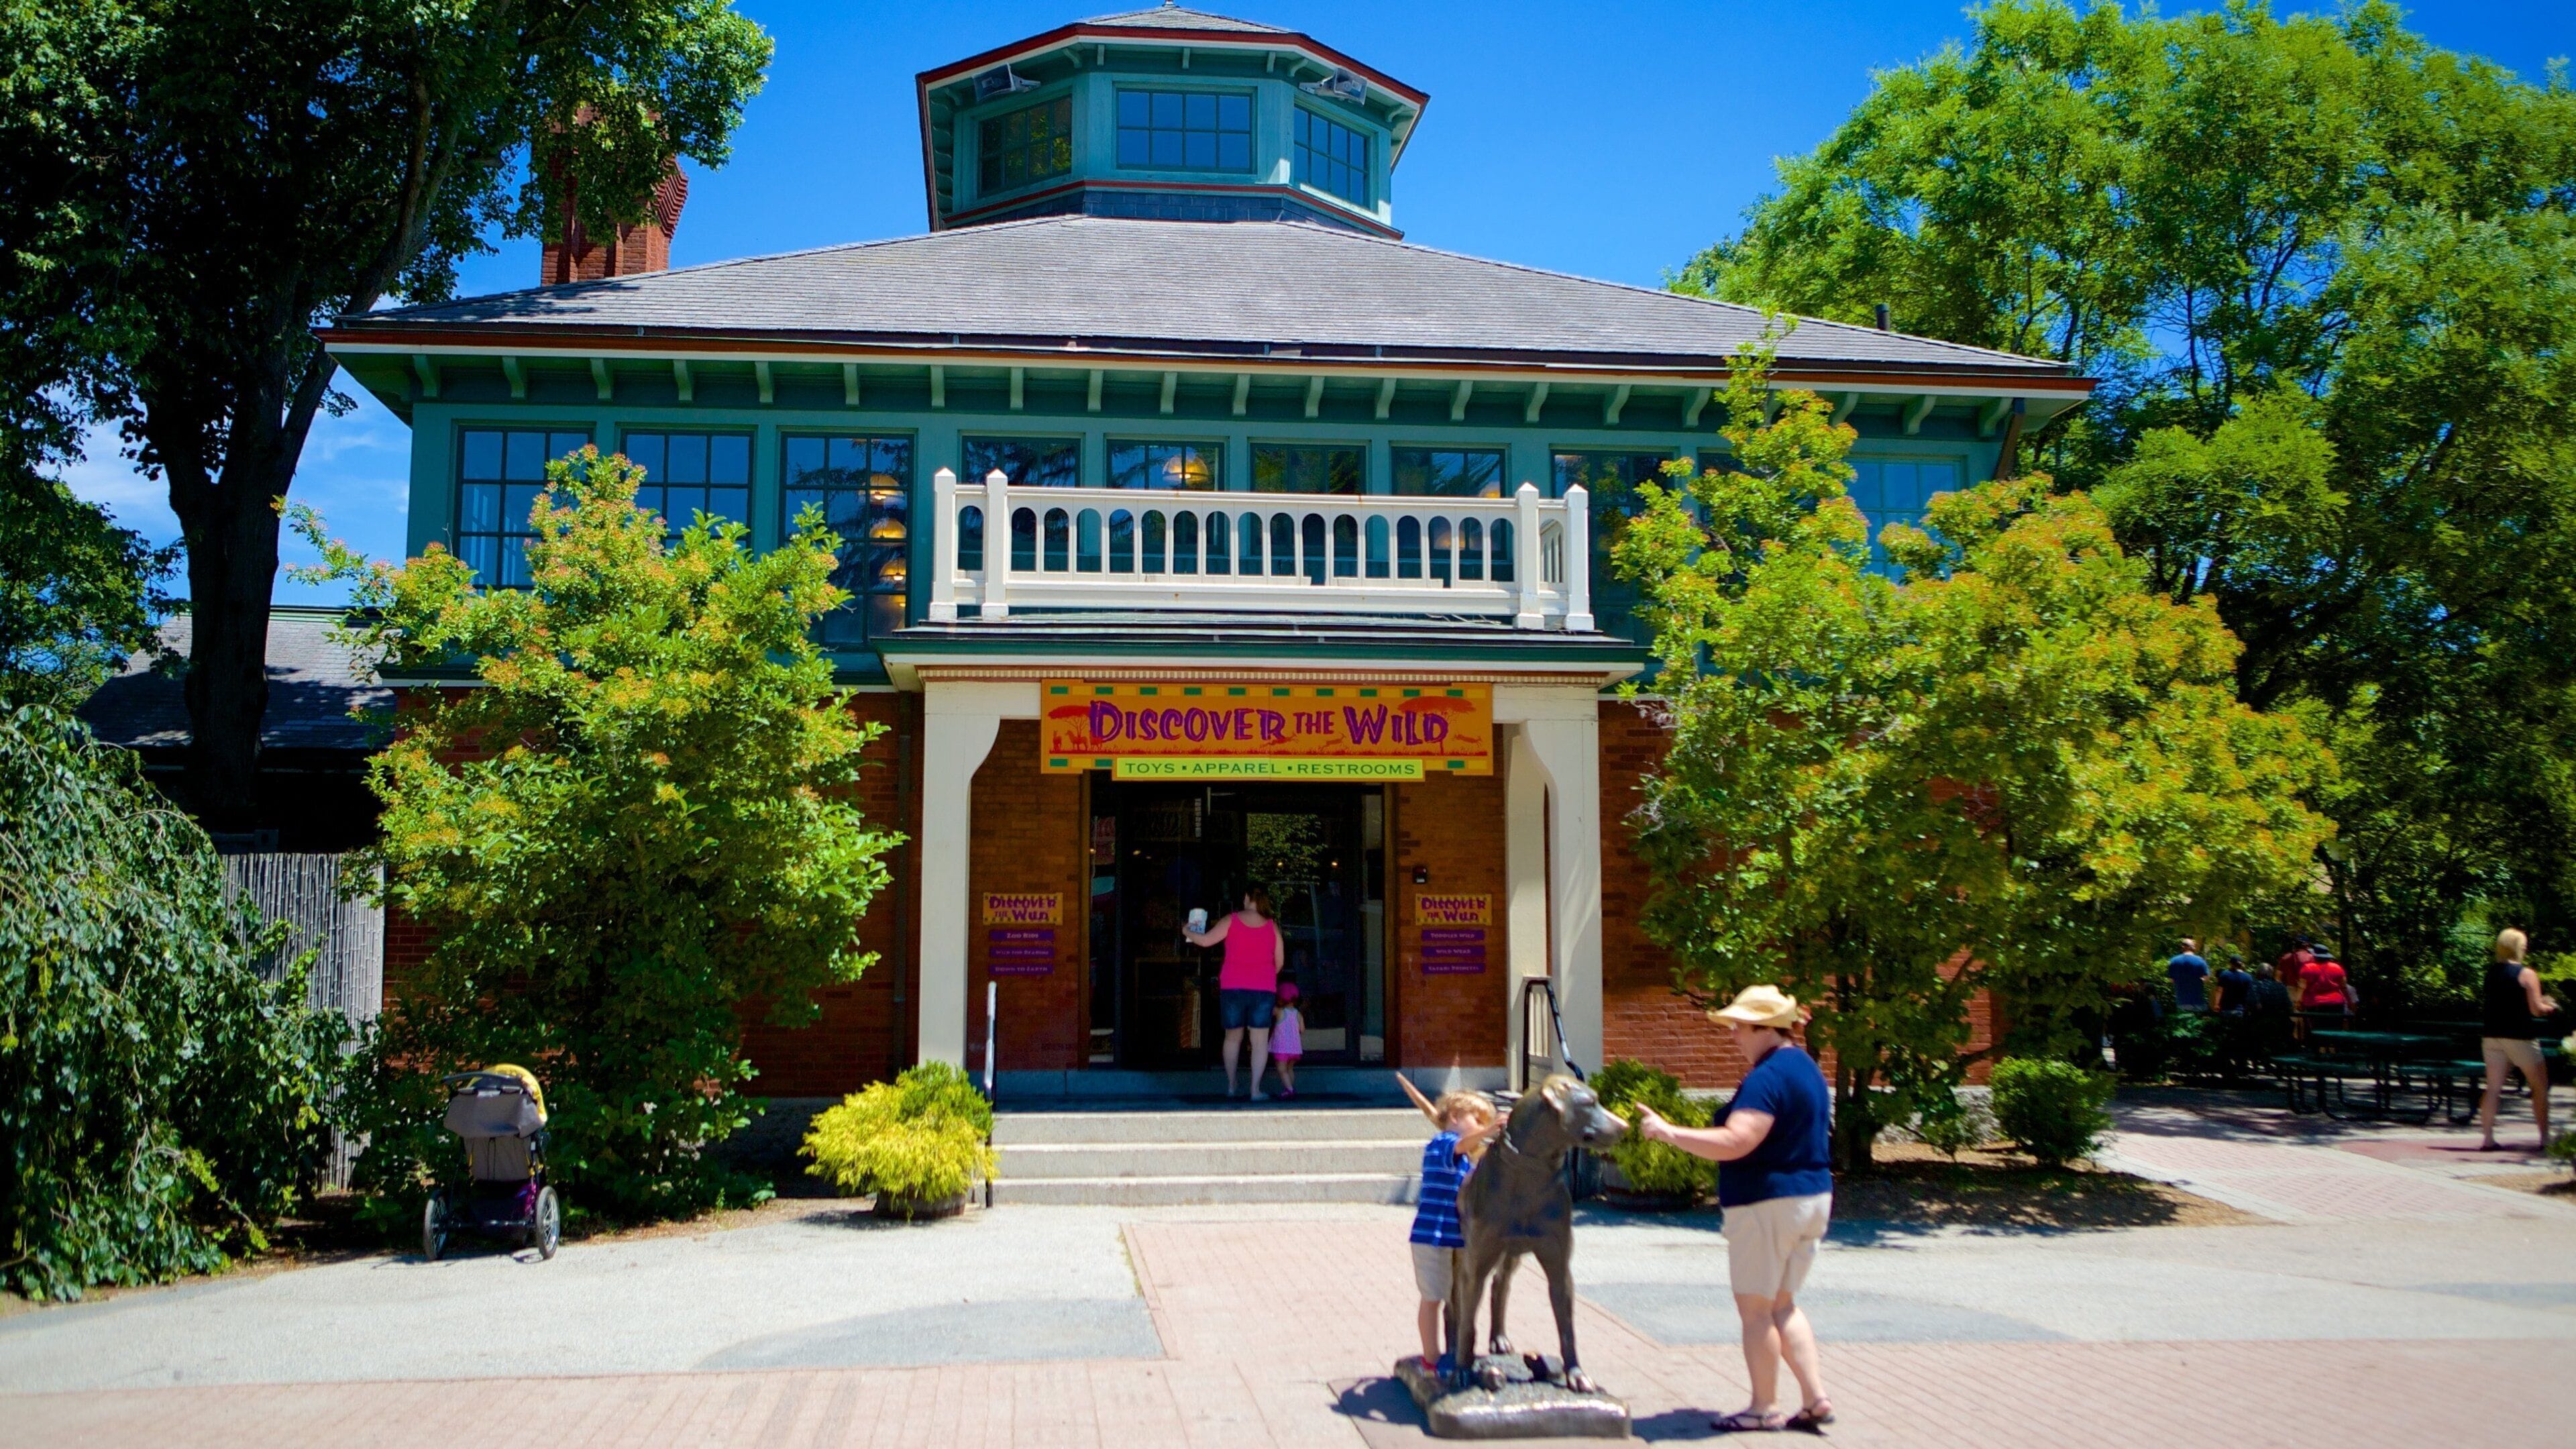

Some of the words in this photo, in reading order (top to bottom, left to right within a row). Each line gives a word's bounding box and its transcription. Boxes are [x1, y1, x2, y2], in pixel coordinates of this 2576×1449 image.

[1089, 700, 1287, 743] DISCOVER
[1293, 711, 1336, 735] THE
[1343, 704, 1448, 746] WILD
[1125, 763, 1175, 774] TOYS
[1191, 763, 1282, 775] APPAREL
[1297, 763, 1415, 775] RESTROOMS
